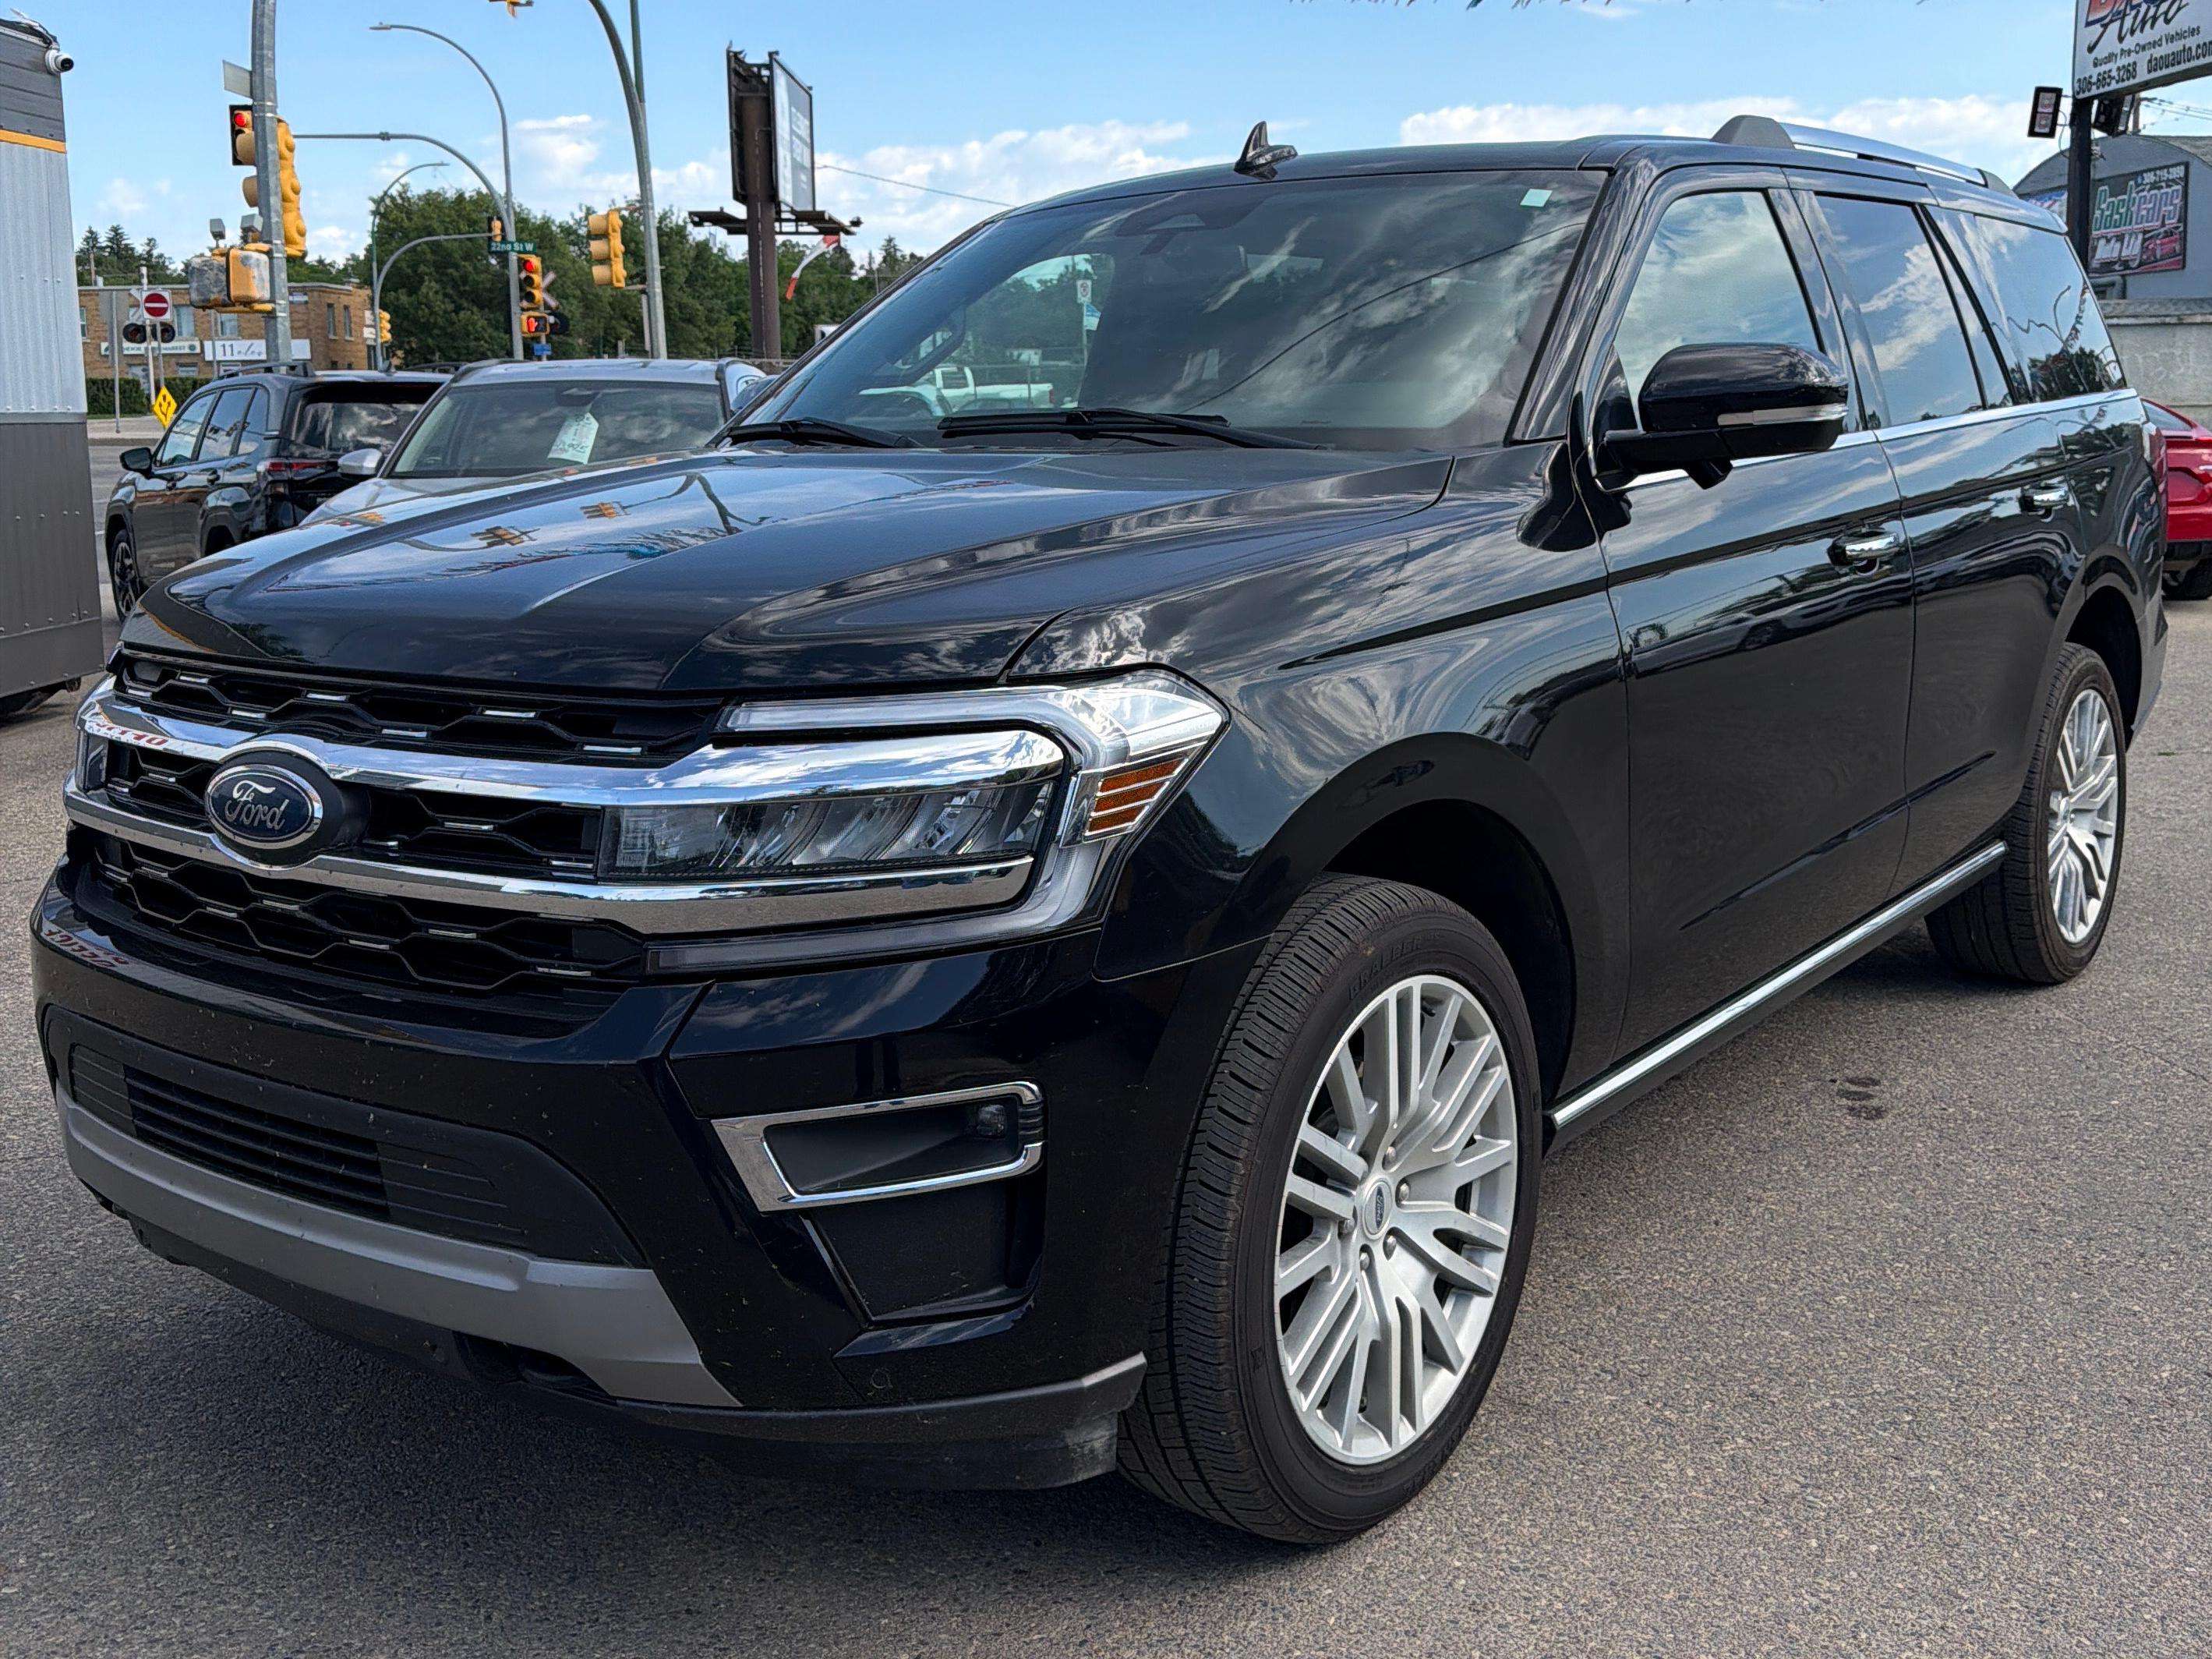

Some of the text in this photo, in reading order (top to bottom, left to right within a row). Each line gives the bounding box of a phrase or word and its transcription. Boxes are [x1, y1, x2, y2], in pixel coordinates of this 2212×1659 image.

[2093, 25, 2201, 69] Quality Pre-Owned Vehicles
[491, 242, 534, 251] 22nd St W
[224, 780, 290, 831] Ford
